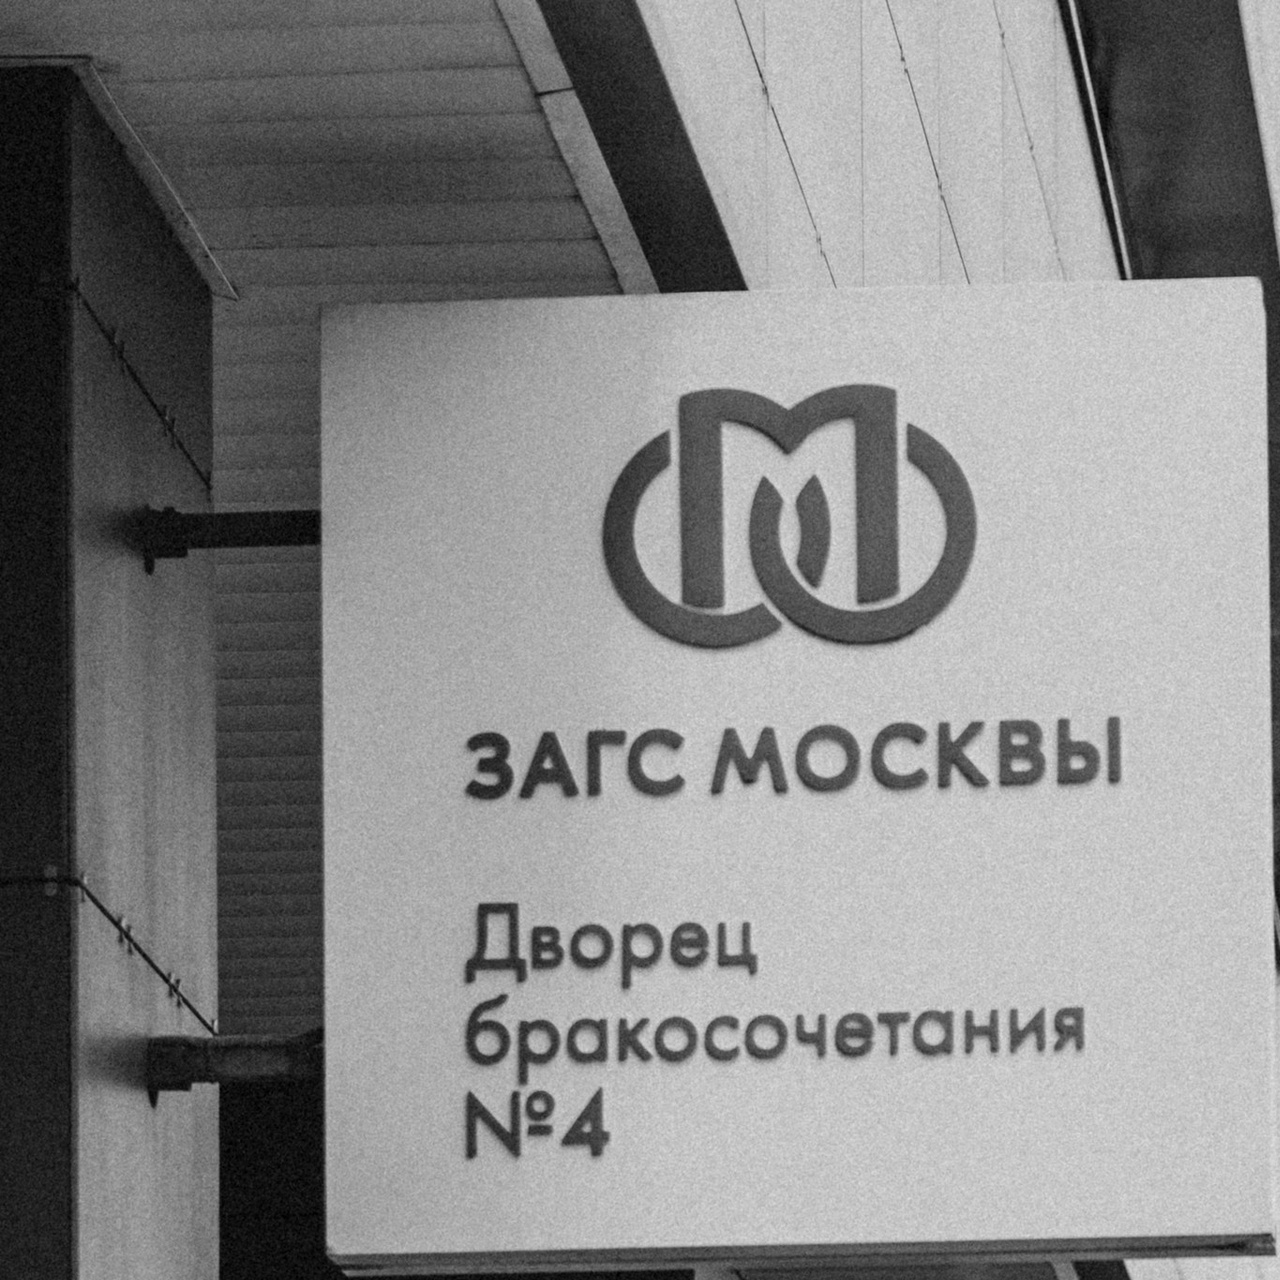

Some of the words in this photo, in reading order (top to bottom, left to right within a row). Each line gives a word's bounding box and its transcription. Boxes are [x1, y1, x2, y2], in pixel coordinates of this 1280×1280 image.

[464, 729, 686, 802] ЗАГС
[710, 716, 1122, 796] МОСКВЫ
[464, 901, 758, 990] Дворец
[464, 993, 1085, 1086] бракосочетания
[464, 1088, 610, 1160] №4
